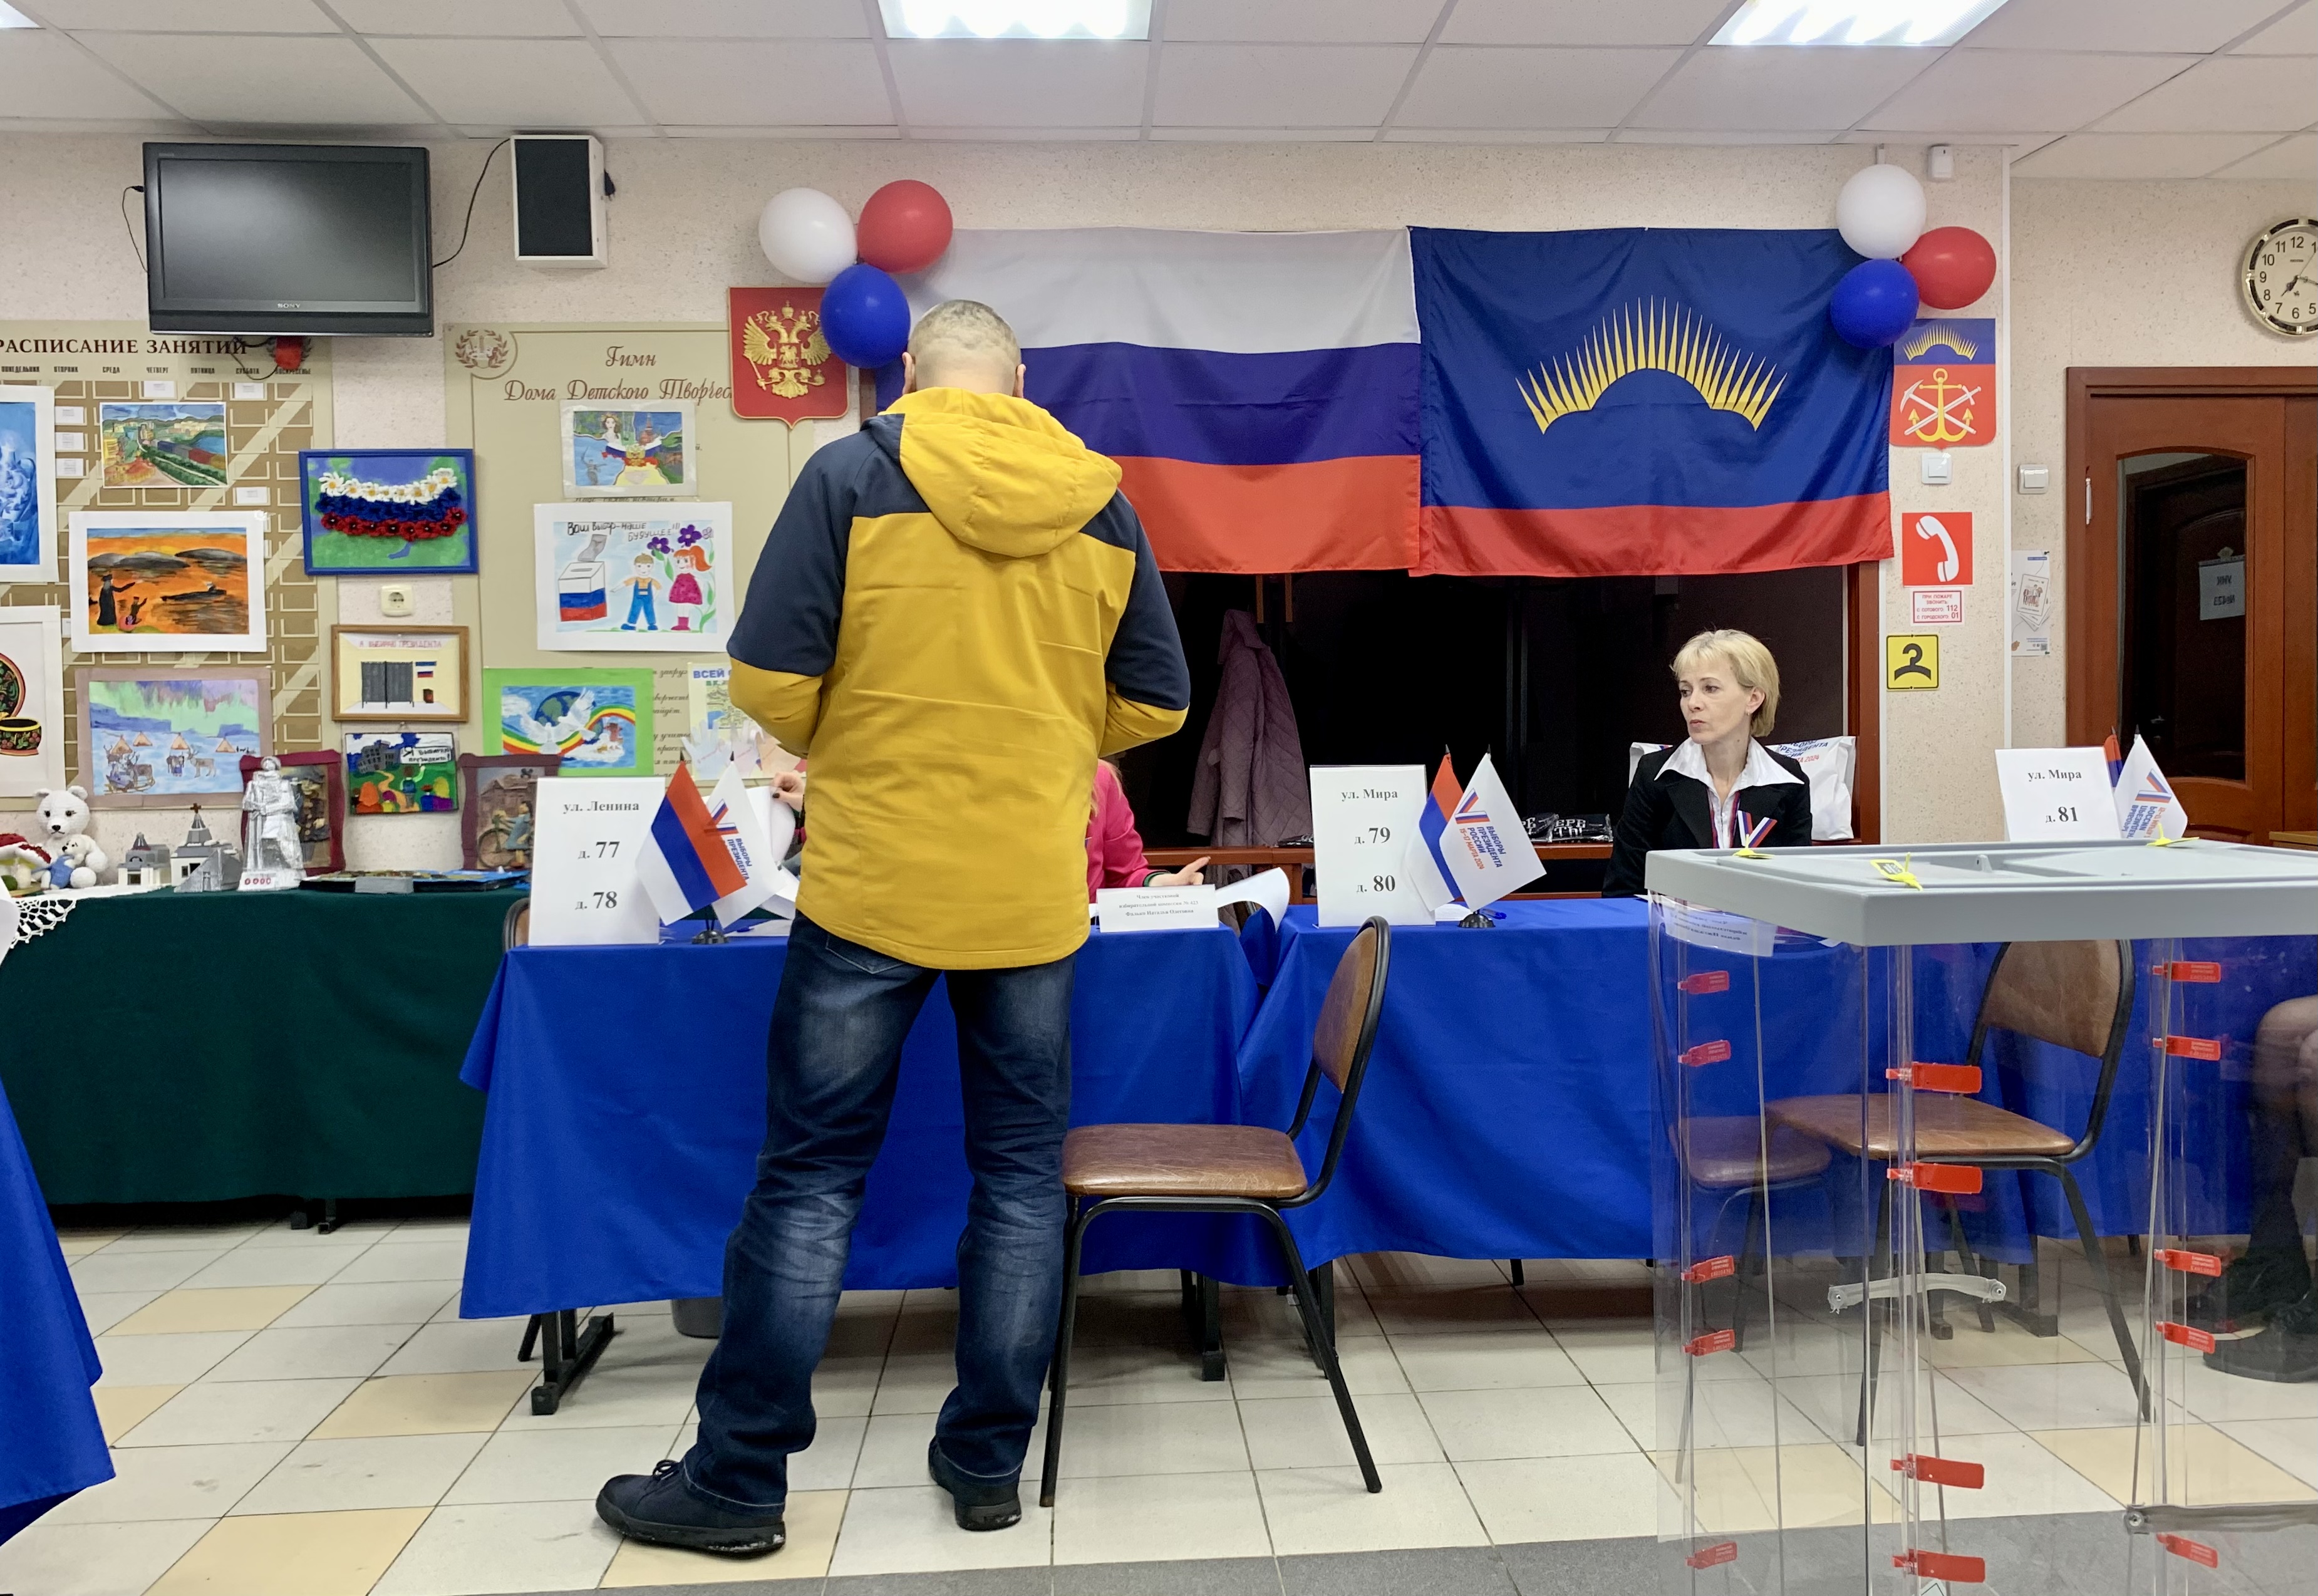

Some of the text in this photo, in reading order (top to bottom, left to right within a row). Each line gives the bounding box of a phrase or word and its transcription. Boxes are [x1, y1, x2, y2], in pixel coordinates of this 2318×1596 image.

[2275, 241, 2285, 252] 11
[2290, 236, 2304, 248] 12
[2311, 241, 2316, 253] 1
[2262, 254, 2275, 266] 10
[2259, 271, 2267, 283] 9
[2264, 289, 2270, 301] 8
[2275, 303, 2283, 314] 7
[2292, 308, 2299, 319] 6
[2309, 303, 2316, 314] 5
[605, 346, 656, 366] Гимн
[504, 380, 556, 401] Дома
[567, 378, 649, 400] Детского
[693, 668, 725, 679] ВСЕЙ
[1804, 754, 1819, 762] 2024
[2028, 769, 2082, 782] ул. Мира
[1341, 789, 1398, 802] ул. Мира
[563, 801, 639, 814] ул. Ленина
[2045, 806, 2079, 823] д. 81
[1354, 827, 1390, 845] д. 79
[1467, 827, 1486, 853] РОССИИ
[1486, 826, 1506, 854] ВЫБОРЫ
[577, 841, 620, 859] д. 77
[735, 838, 752, 867] ВЫБОРЫ
[1466, 841, 1479, 858] МАРТА
[1476, 827, 1503, 868] ПРЕЗИДЕНТА
[727, 839, 750, 880] ПРЕЗИДЕНТА
[1356, 874, 1395, 893] д. 80
[574, 891, 618, 910] д. 78
